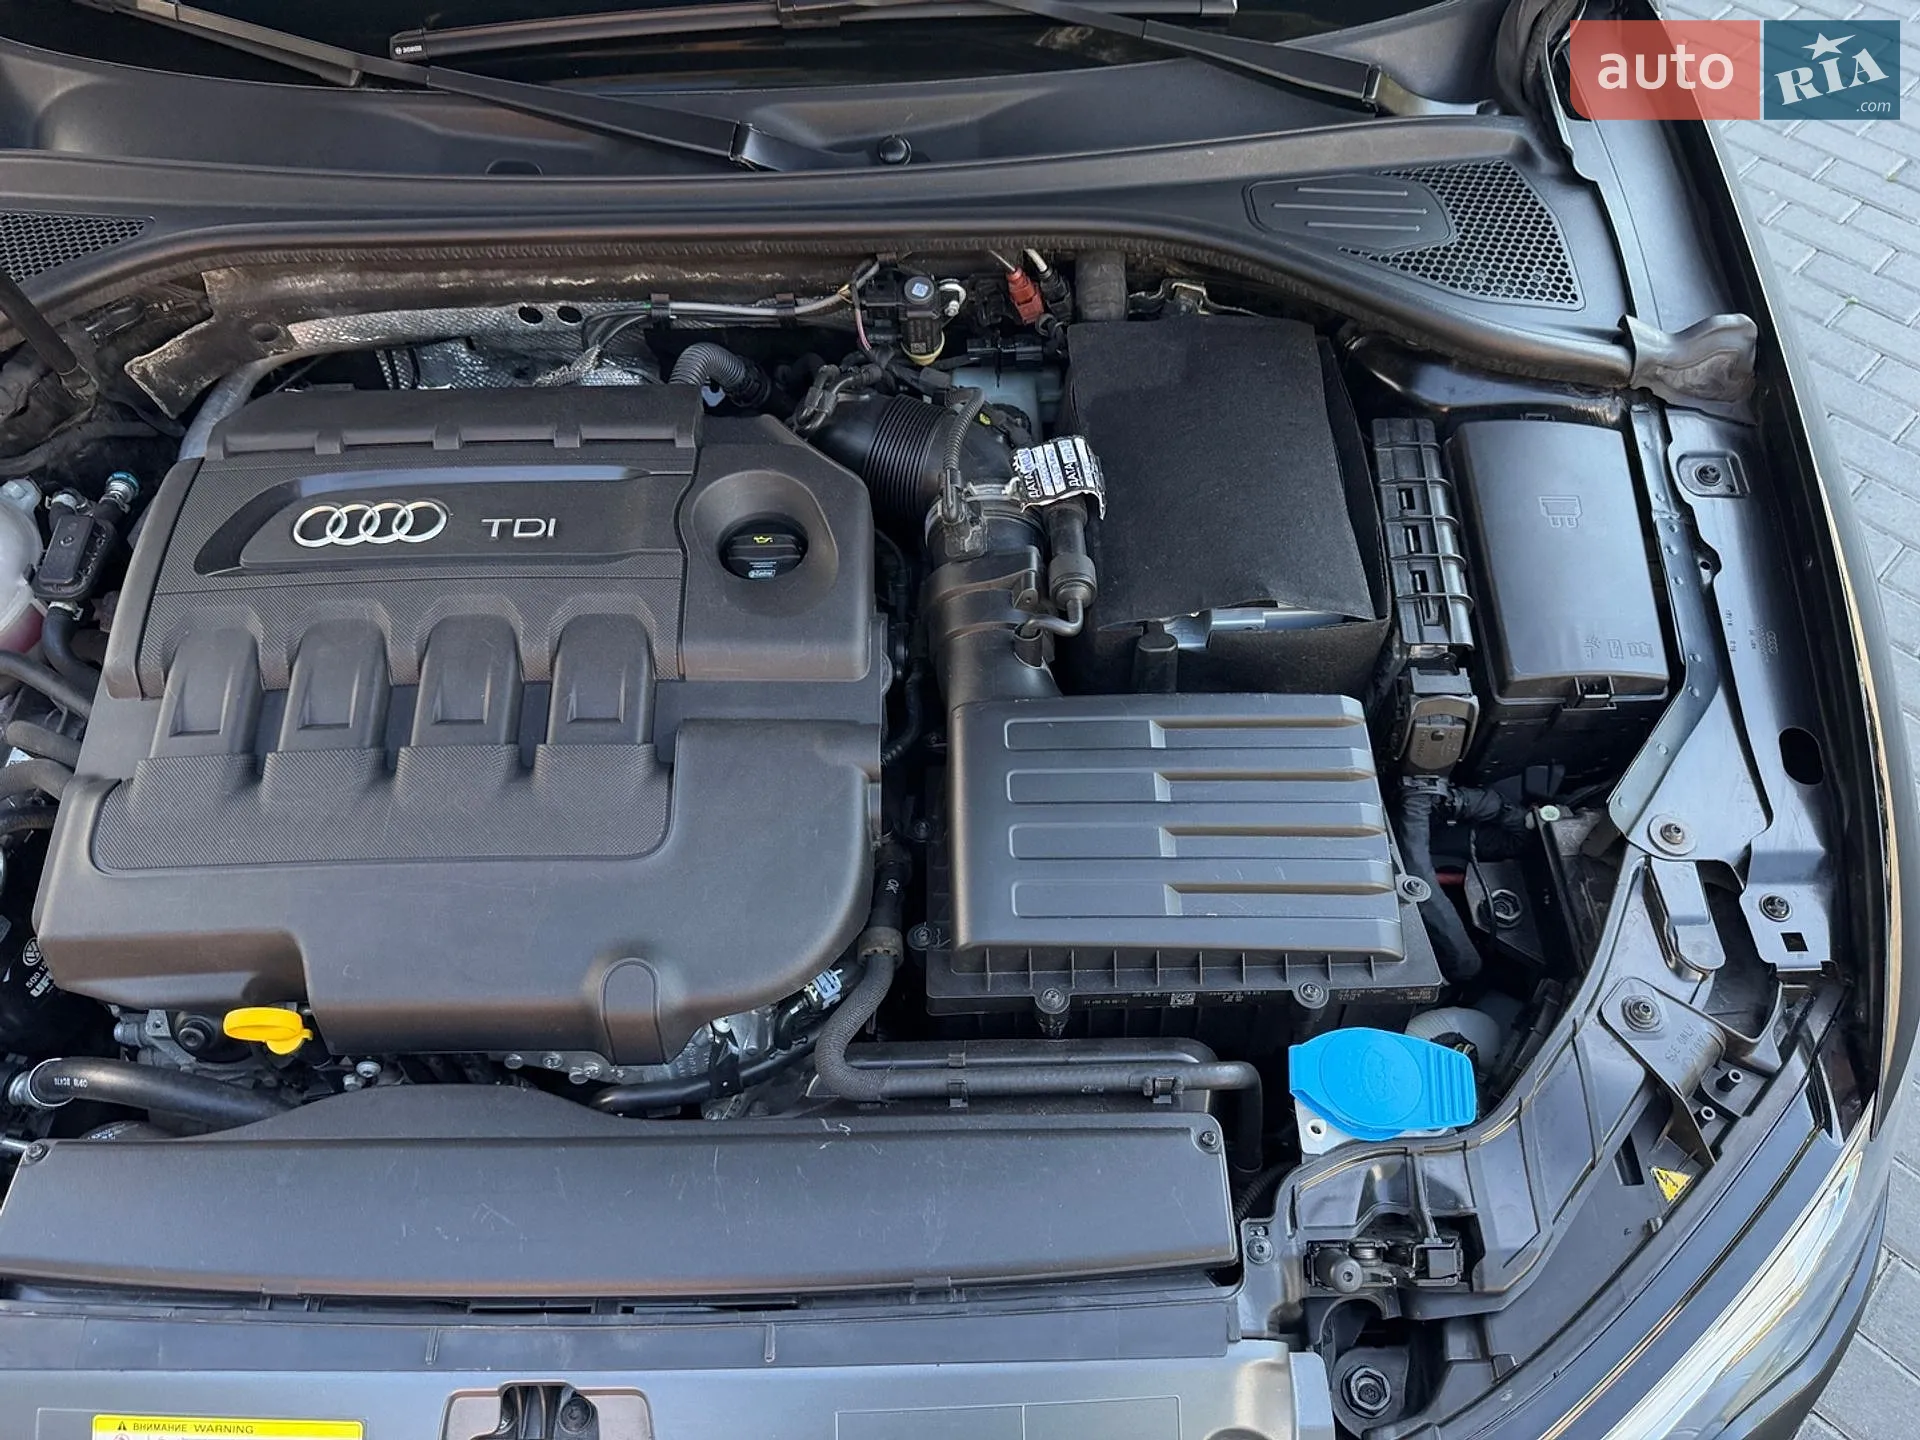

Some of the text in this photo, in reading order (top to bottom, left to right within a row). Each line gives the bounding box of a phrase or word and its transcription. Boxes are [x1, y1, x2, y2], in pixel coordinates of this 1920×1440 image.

[481, 518, 556, 538] TDI
[885, 879, 900, 894] OK
[133, 1422, 254, 1434] ВНИМАНИЕ WARNING
